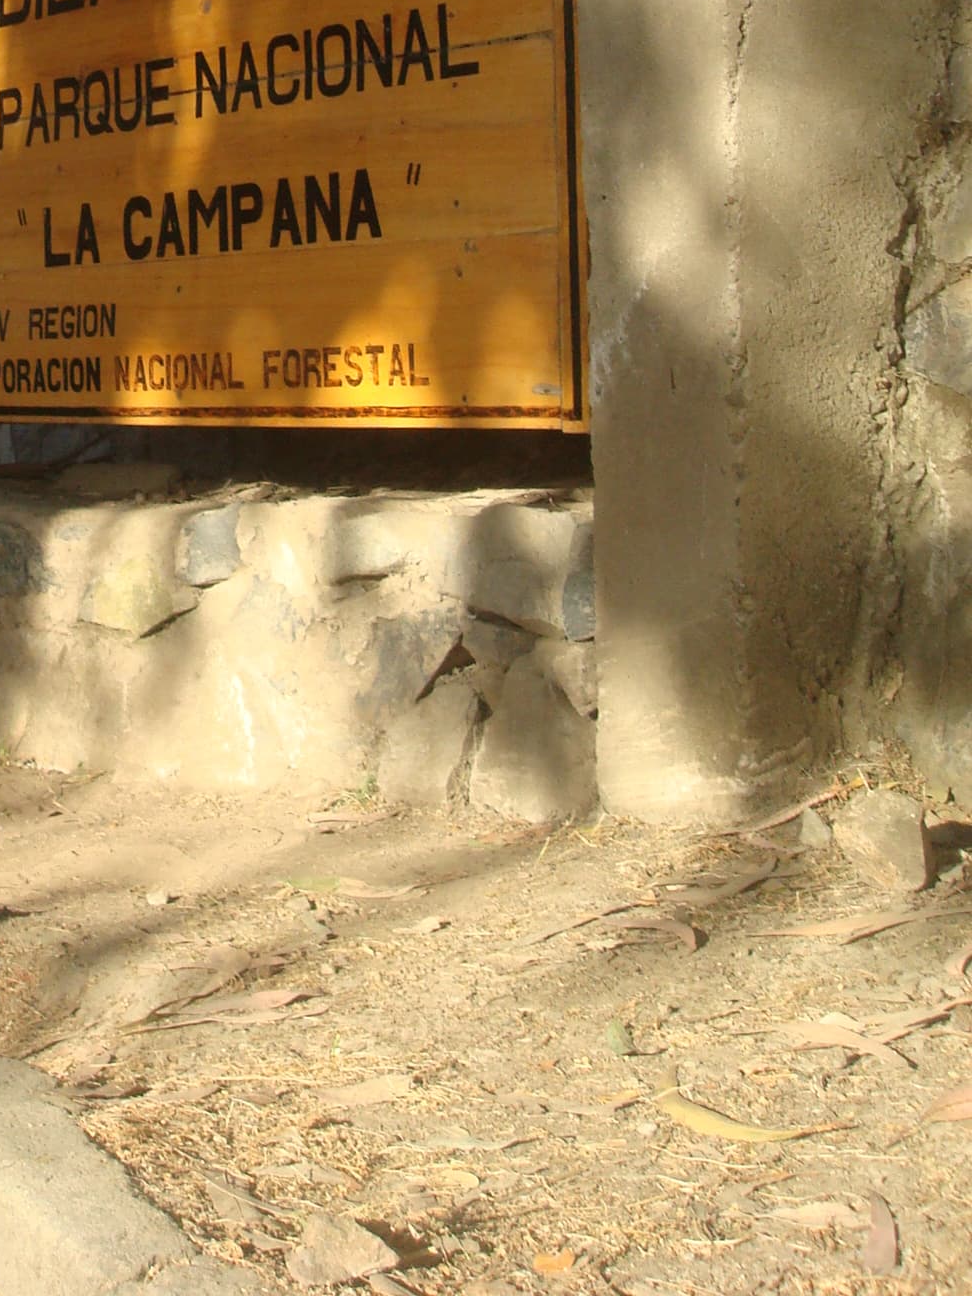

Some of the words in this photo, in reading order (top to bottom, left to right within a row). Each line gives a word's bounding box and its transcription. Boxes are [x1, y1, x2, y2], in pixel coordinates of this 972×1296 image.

[194, 4, 480, 118] NACIONAL
[28, 303, 117, 342] REGION
[114, 351, 244, 392] NACIONAL
[262, 342, 430, 390] FORESTAL
